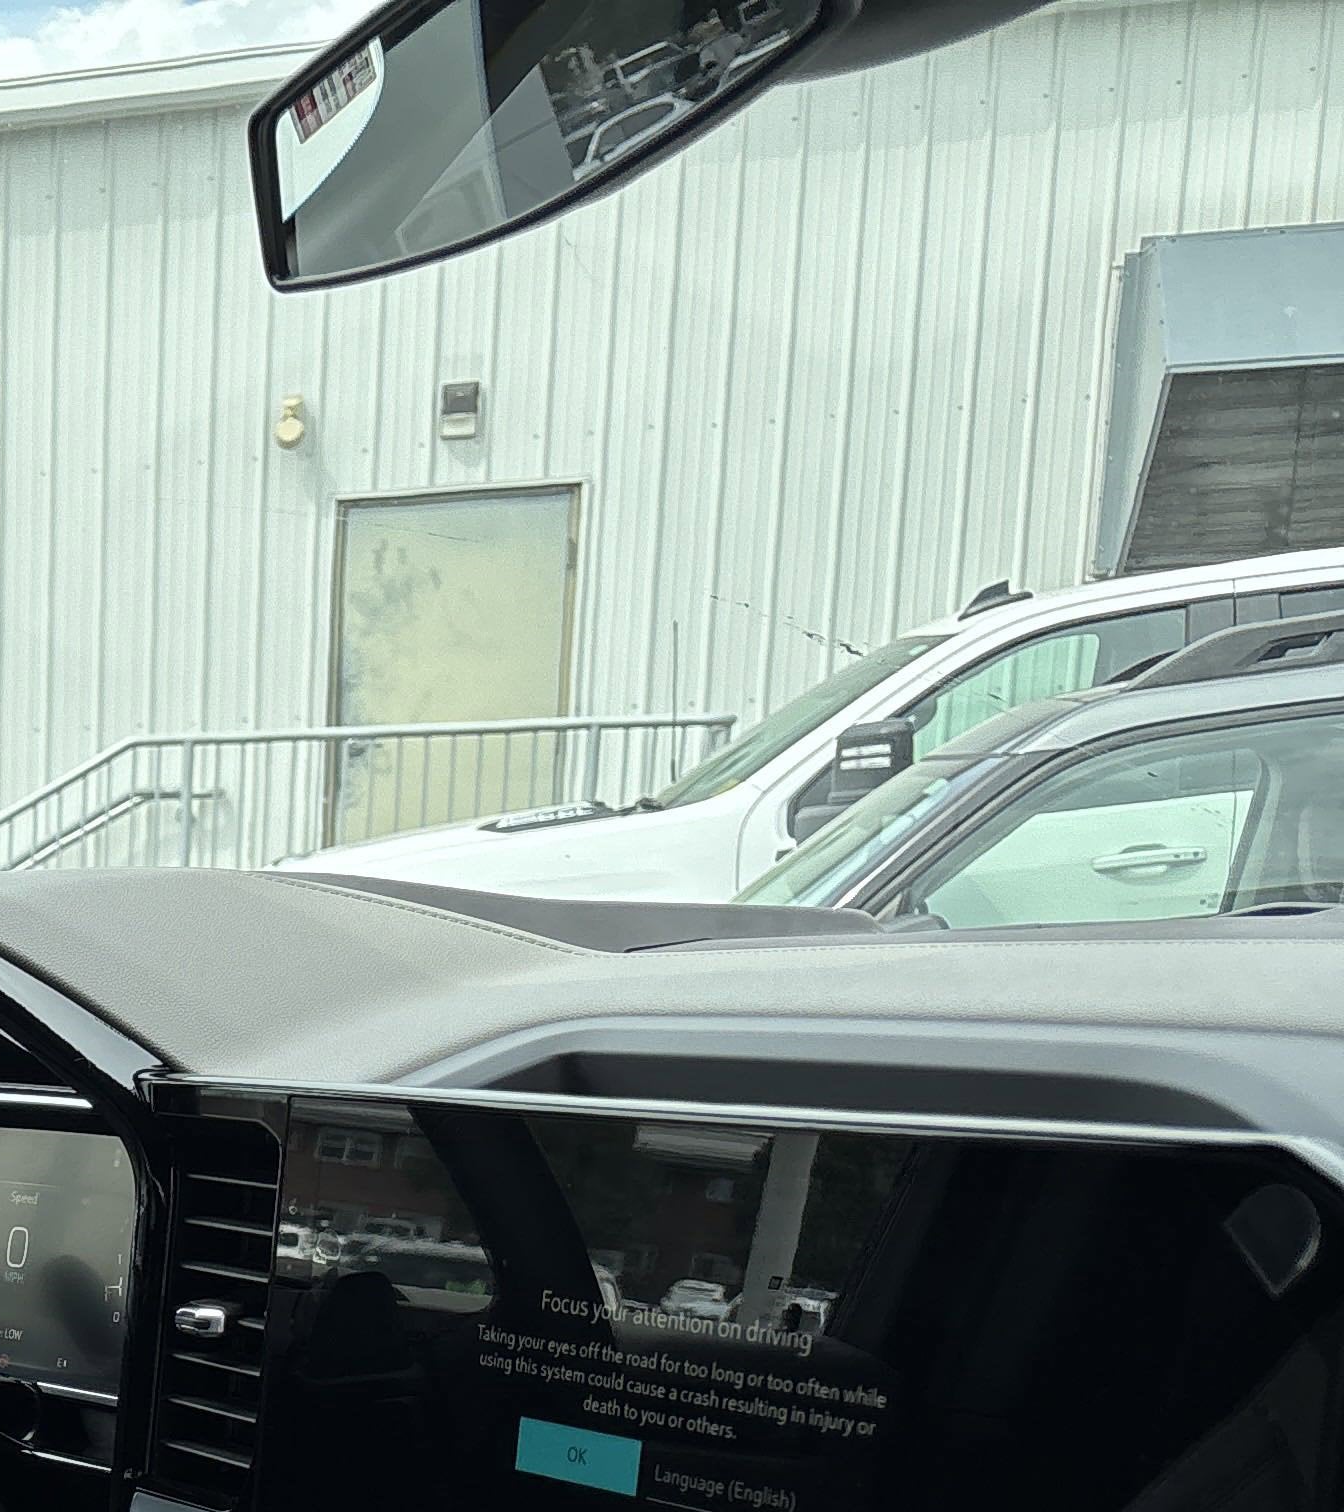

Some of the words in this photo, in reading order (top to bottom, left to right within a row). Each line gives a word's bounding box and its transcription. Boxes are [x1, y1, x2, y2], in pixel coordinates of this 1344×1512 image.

[10, 1191, 40, 1205] Speed
[6, 1226, 29, 1268] 0
[4, 1329, 24, 1341] LOW
[541, 1290, 588, 1315] Focus
[591, 1303, 630, 1324] your
[633, 1305, 713, 1336] attention
[718, 1322, 741, 1339] on
[746, 1320, 812, 1356] driving
[478, 1324, 515, 1348] Taking
[518, 1335, 546, 1350] your
[548, 1339, 576, 1358] eyes
[579, 1342, 600, 1359] off
[601, 1345, 623, 1363] the
[626, 1352, 658, 1370] road
[661, 1354, 680, 1374] for
[683, 1360, 708, 1378] too
[712, 1363, 744, 1388] long
[748, 1374, 764, 1386] or
[767, 1374, 793, 1392] too
[796, 1378, 839, 1399] often
[843, 1385, 887, 1408] while
[480, 1352, 512, 1374] using
[515, 1357, 537, 1375] this
[541, 1365, 585, 1383] system
[588, 1373, 624, 1391] could
[627, 1380, 665, 1398] cause
[669, 1388, 677, 1400] a
[680, 1390, 719, 1408] crash
[722, 1397, 787, 1425] resulting
[791, 1405, 805, 1423] in
[809, 1408, 854, 1436] injury
[857, 1421, 876, 1436] or
[583, 1395, 620, 1417] death
[624, 1405, 637, 1420] to
[641, 1410, 665, 1427] you
[668, 1416, 684, 1429] or
[687, 1416, 737, 1439] others.
[567, 1446, 588, 1466] OK
[654, 1464, 725, 1495] Language
[727, 1480, 796, 1512] (English)
